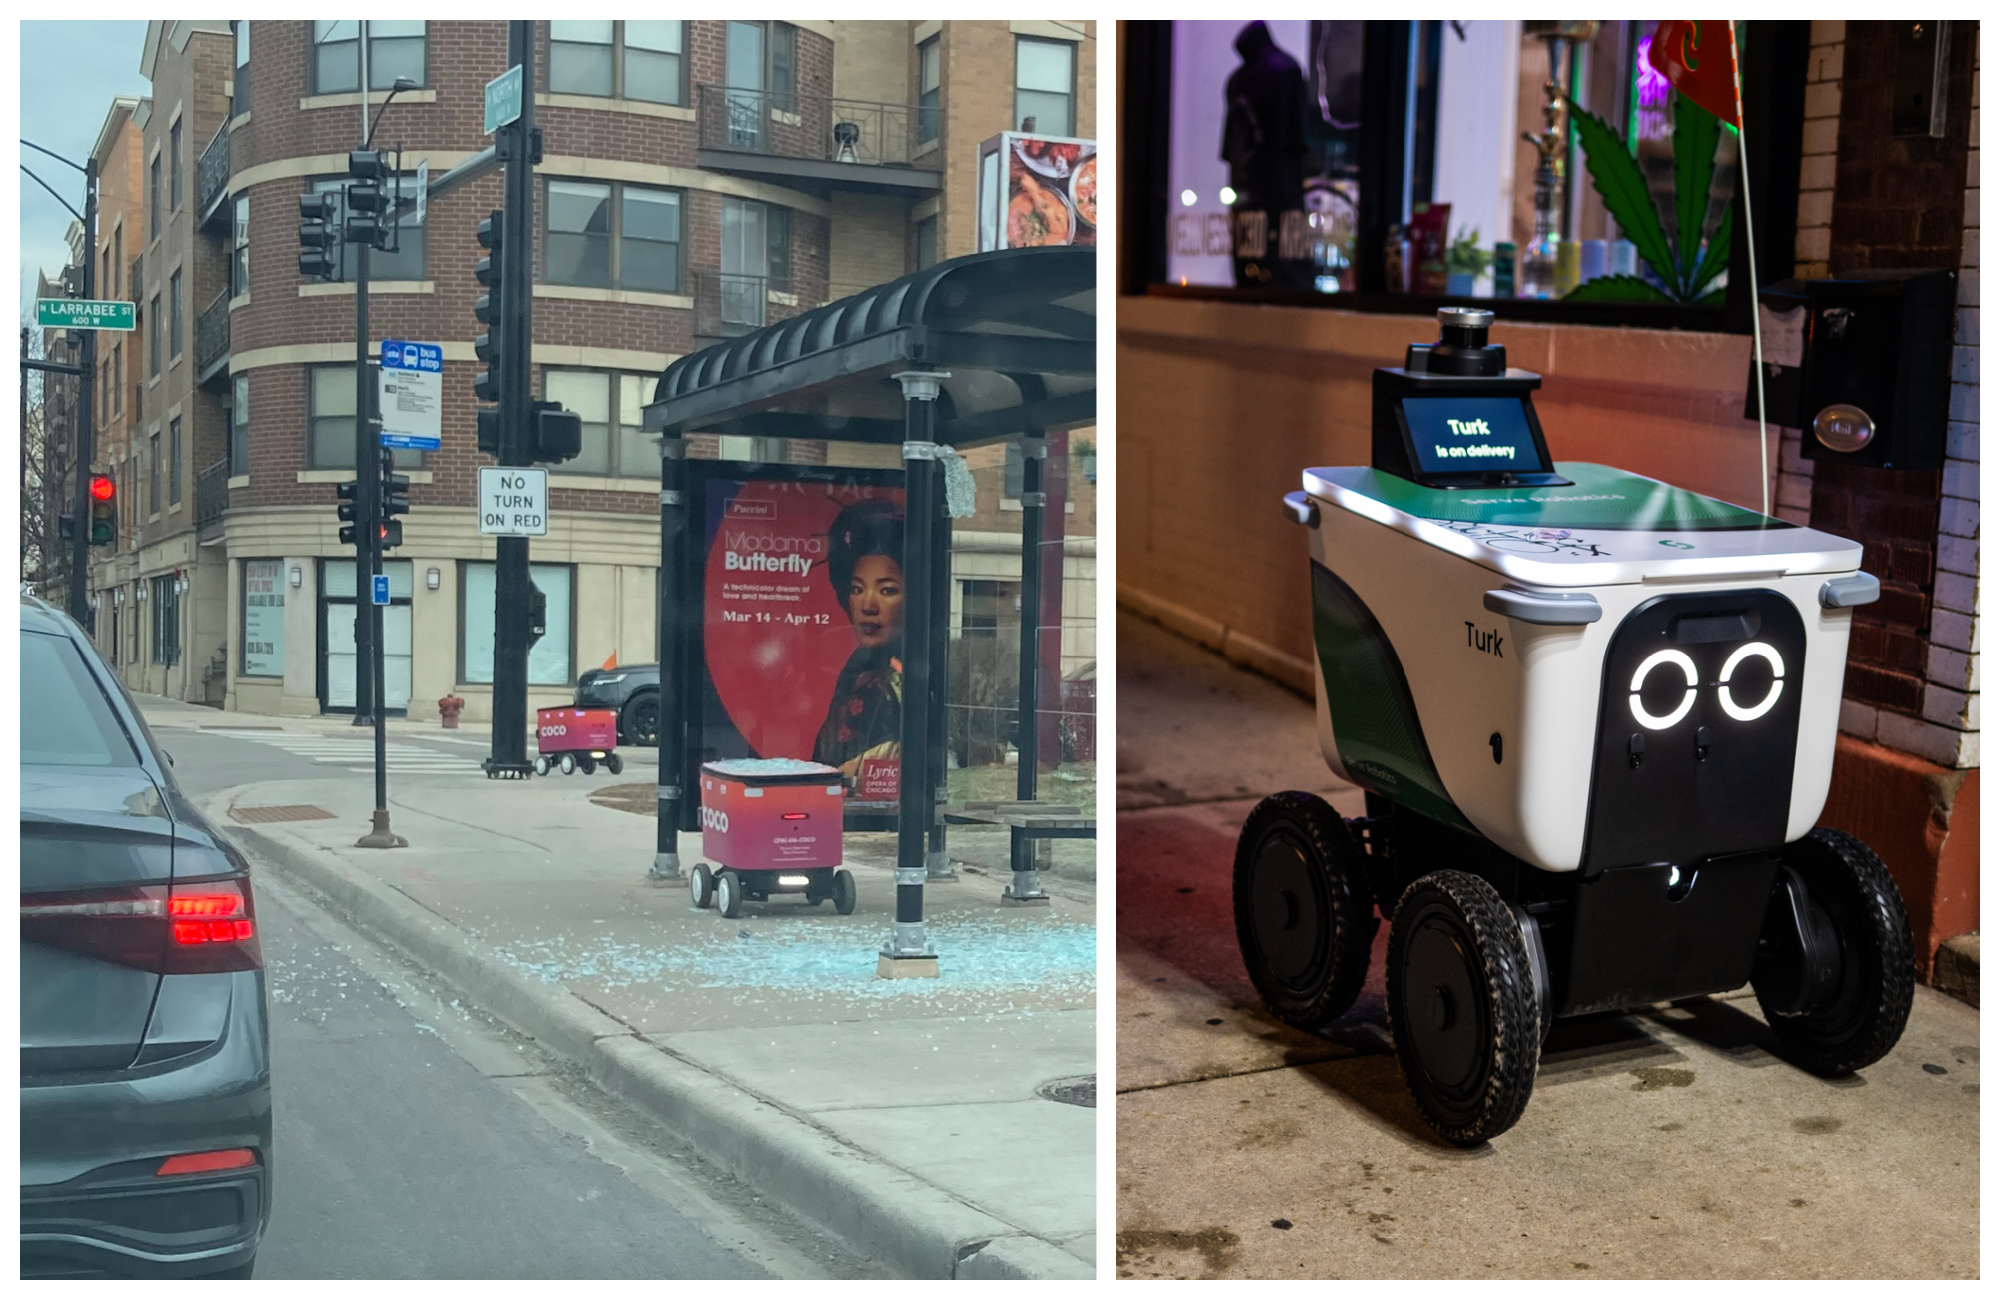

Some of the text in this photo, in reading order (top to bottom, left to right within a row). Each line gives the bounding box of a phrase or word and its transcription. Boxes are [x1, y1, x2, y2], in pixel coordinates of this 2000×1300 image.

[40, 303, 132, 317] N LARRABEE ST
[72, 316, 101, 326] 600 W
[420, 346, 437, 359] bus
[420, 358, 440, 371] stop
[1446, 418, 1491, 436] Turk
[1435, 443, 1516, 460] is on delivery
[501, 476, 526, 490] NO
[493, 494, 533, 508] TURN
[1460, 497, 1528, 505] Serve
[734, 504, 768, 515] Puccini
[485, 513, 542, 528] ON RED
[724, 530, 821, 554] Madama
[724, 551, 813, 577] Butterfly
[723, 583, 811, 594] A technicolor dream of
[758, 593, 802, 602] heartbreak.
[723, 610, 752, 622] Mar
[755, 612, 771, 623] 14
[784, 612, 810, 626] Apr
[814, 613, 830, 625] 12
[1464, 620, 1504, 658] Turk
[866, 764, 899, 780] Lyric
[1365, 763, 1397, 785] Robotics
[865, 780, 887, 788] OPERA
